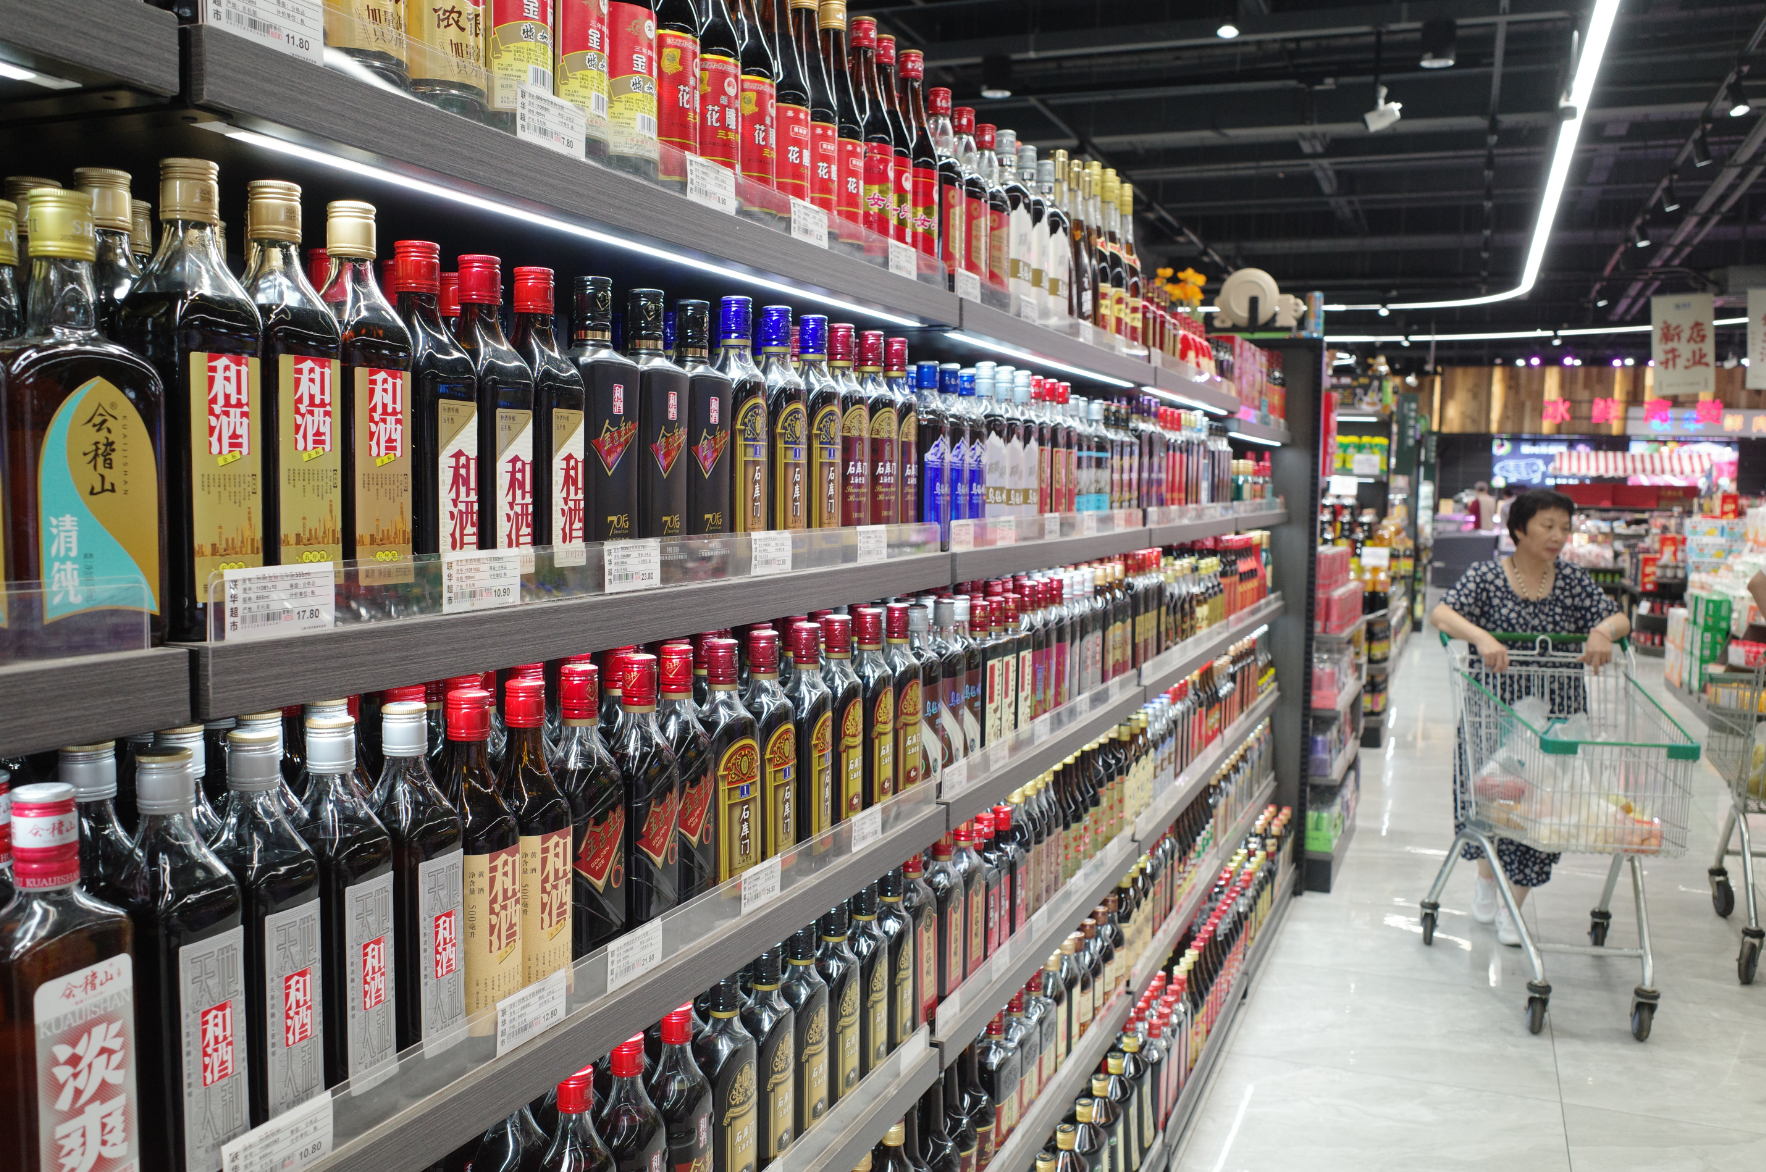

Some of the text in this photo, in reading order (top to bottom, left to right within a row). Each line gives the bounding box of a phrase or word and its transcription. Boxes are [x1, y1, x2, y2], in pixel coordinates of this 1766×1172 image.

[285, 33, 310, 51] 11.80
[561, 136, 574, 149] 7.80
[1659, 320, 1707, 345] 新店
[1659, 347, 1710, 370] 开业
[207, 355, 250, 456] 和酒
[294, 359, 333, 452] 和酒
[368, 370, 403, 457] 和酒
[614, 385, 623, 414] 和酒
[669, 392, 677, 420] 和酒
[711, 397, 719, 424] 和酒
[81, 402, 118, 496] 会稽山
[121, 414, 129, 496] KUAIJISHAN
[846, 461, 867, 476] 石库门
[875, 461, 896, 476] 石库门
[448, 448, 479, 551] 和酒
[504, 453, 533, 549] 和酒
[559, 452, 584, 544] 和酒
[752, 466, 761, 518] 石库门
[793, 467, 801, 517] 石库门
[827, 466, 835, 514] 石库门
[50, 513, 82, 606] 清纯
[296, 608, 320, 620] 17.80
[493, 588, 511, 598] 10.90
[28, 819, 76, 838] 会稽山
[702, 813, 712, 845] 6
[739, 804, 750, 855] 石库门
[783, 785, 791, 834] 石库门
[611, 852, 623, 889] 6
[667, 831, 677, 865] 6
[489, 852, 522, 952] 和酒
[541, 834, 572, 930] 和酒
[434, 914, 456, 979] 和酒
[60, 969, 114, 1001] 会稽山
[363, 941, 386, 1010] 和酒
[38, 988, 132, 1039] KUAIJISHAN
[286, 975, 312, 1046] 和酒
[202, 1007, 234, 1085] 和酒
[811, 1057, 828, 1080] 石库门
[51, 1019, 128, 1172] 淡爽
[776, 1087, 793, 1108] 石库门
[299, 1141, 322, 1160] 10.80
[735, 1121, 755, 1145] 石库门
